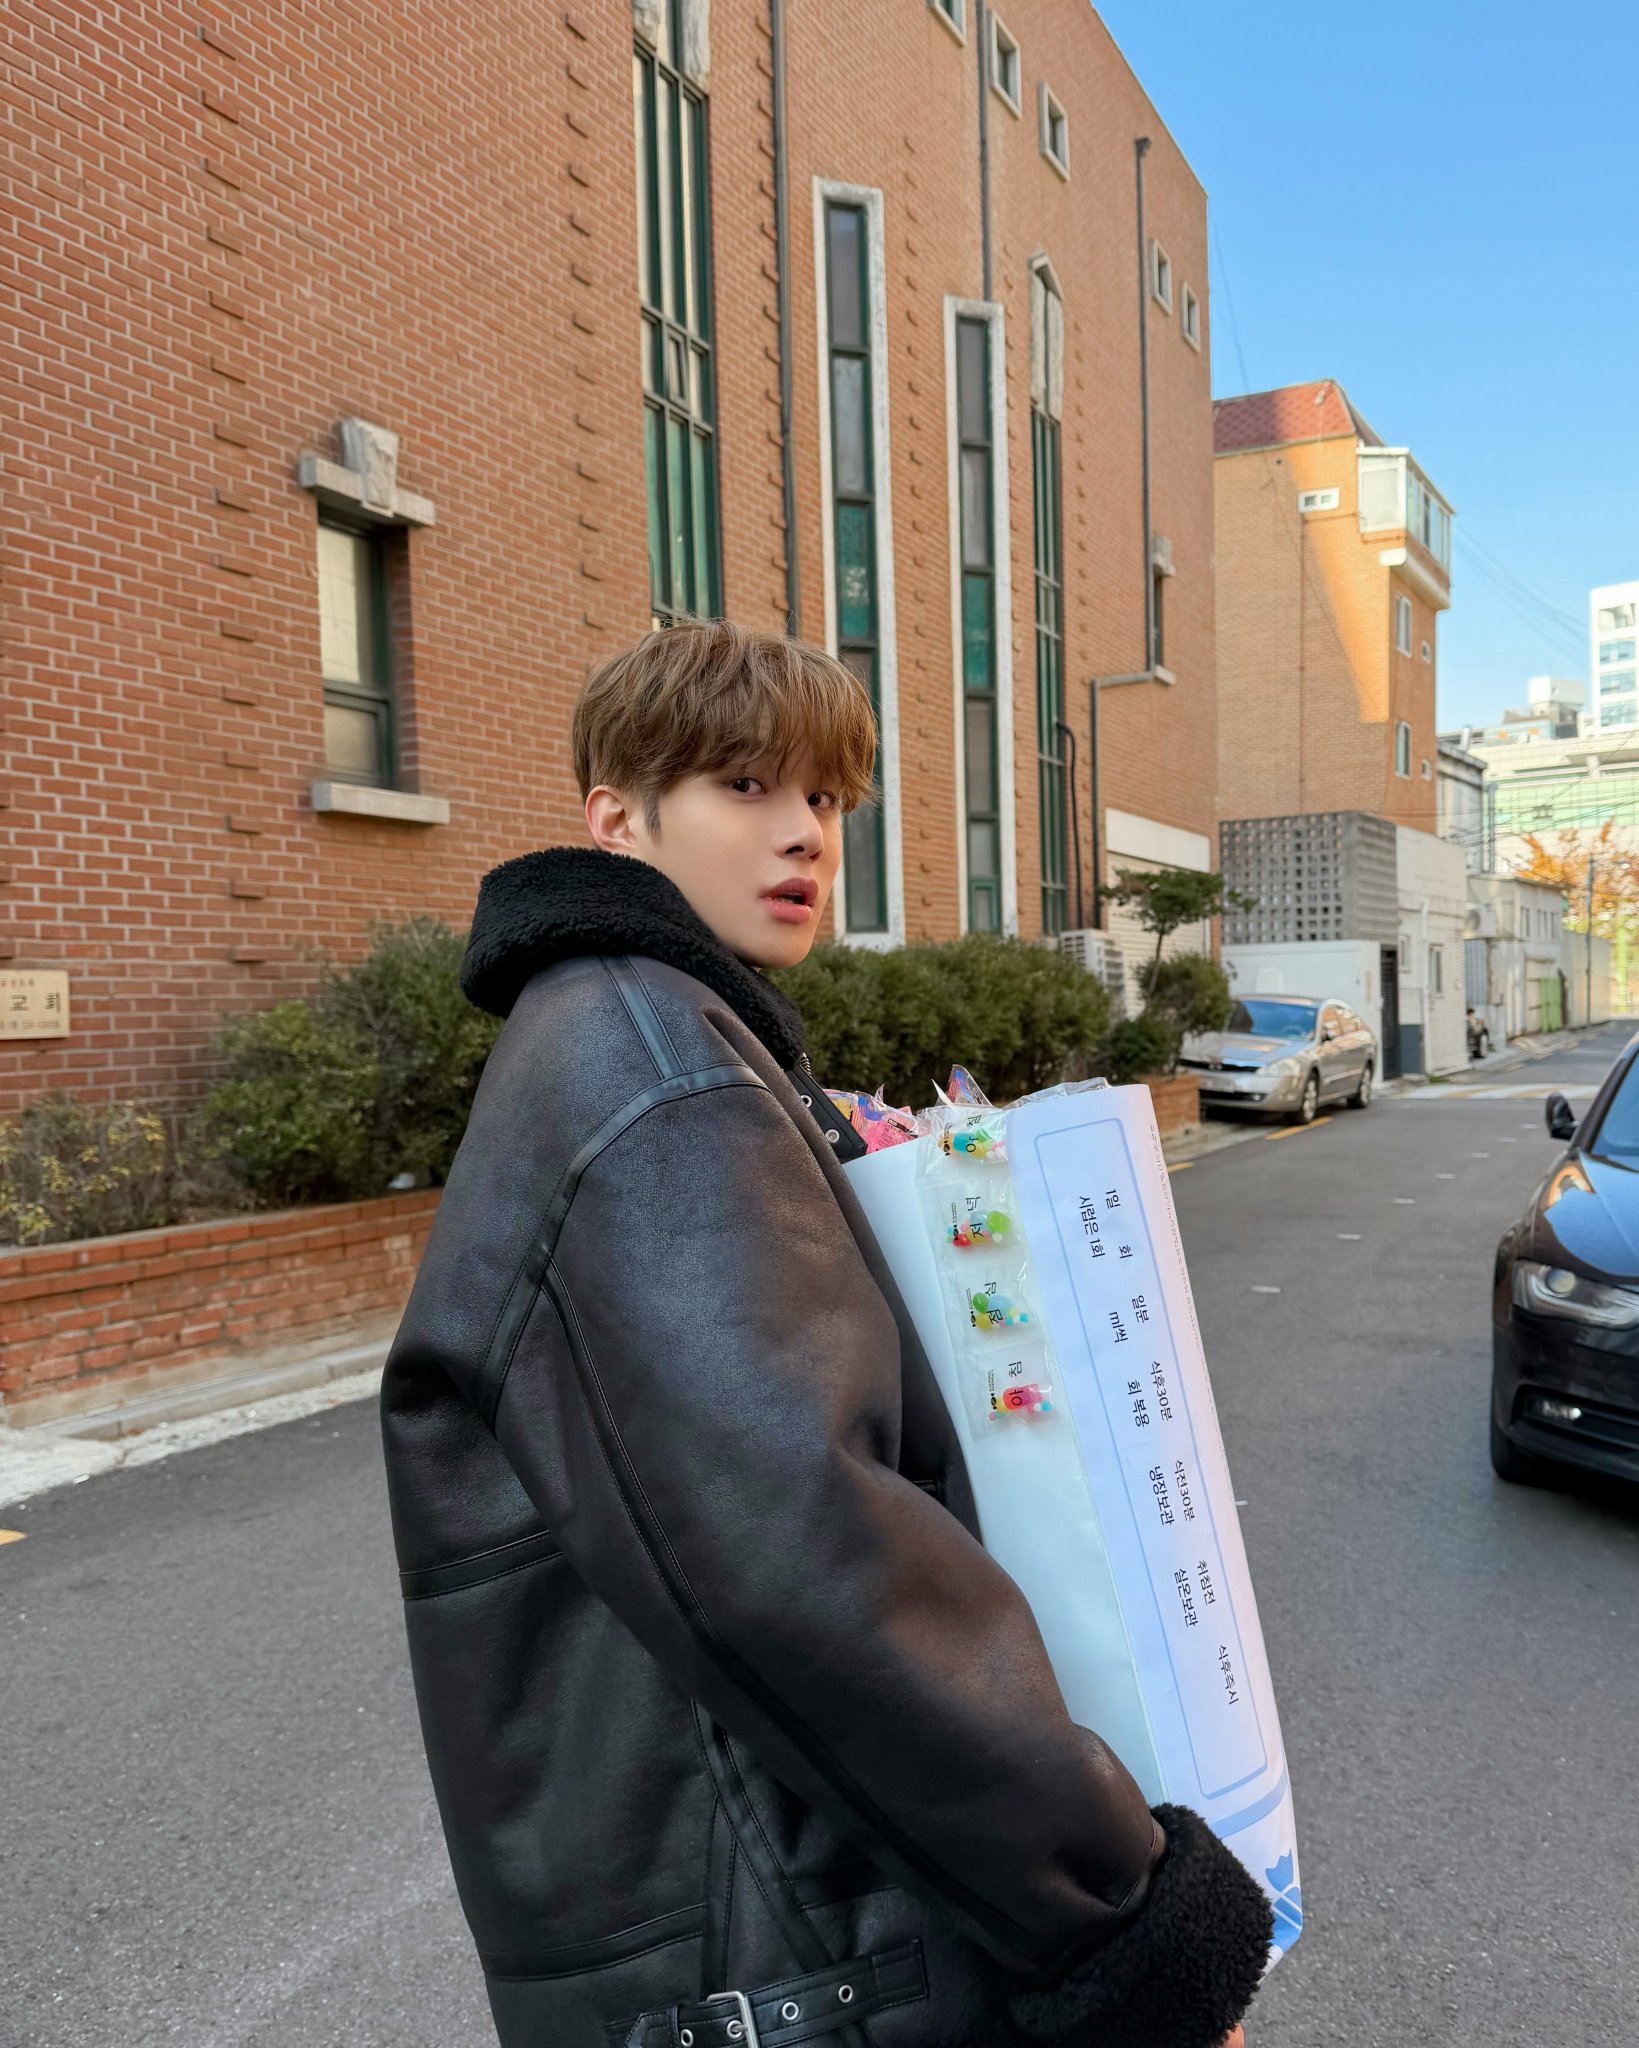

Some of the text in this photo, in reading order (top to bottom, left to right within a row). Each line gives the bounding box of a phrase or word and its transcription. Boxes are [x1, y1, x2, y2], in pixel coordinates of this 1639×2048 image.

[1078, 1196, 1199, 1628] 시럽은 1회 ml씩 회 복용 냉장보관 실온보관
[1105, 1188, 1239, 1705] 1일 회 일분 식후30분 식전30분 취침전 식후즉시
